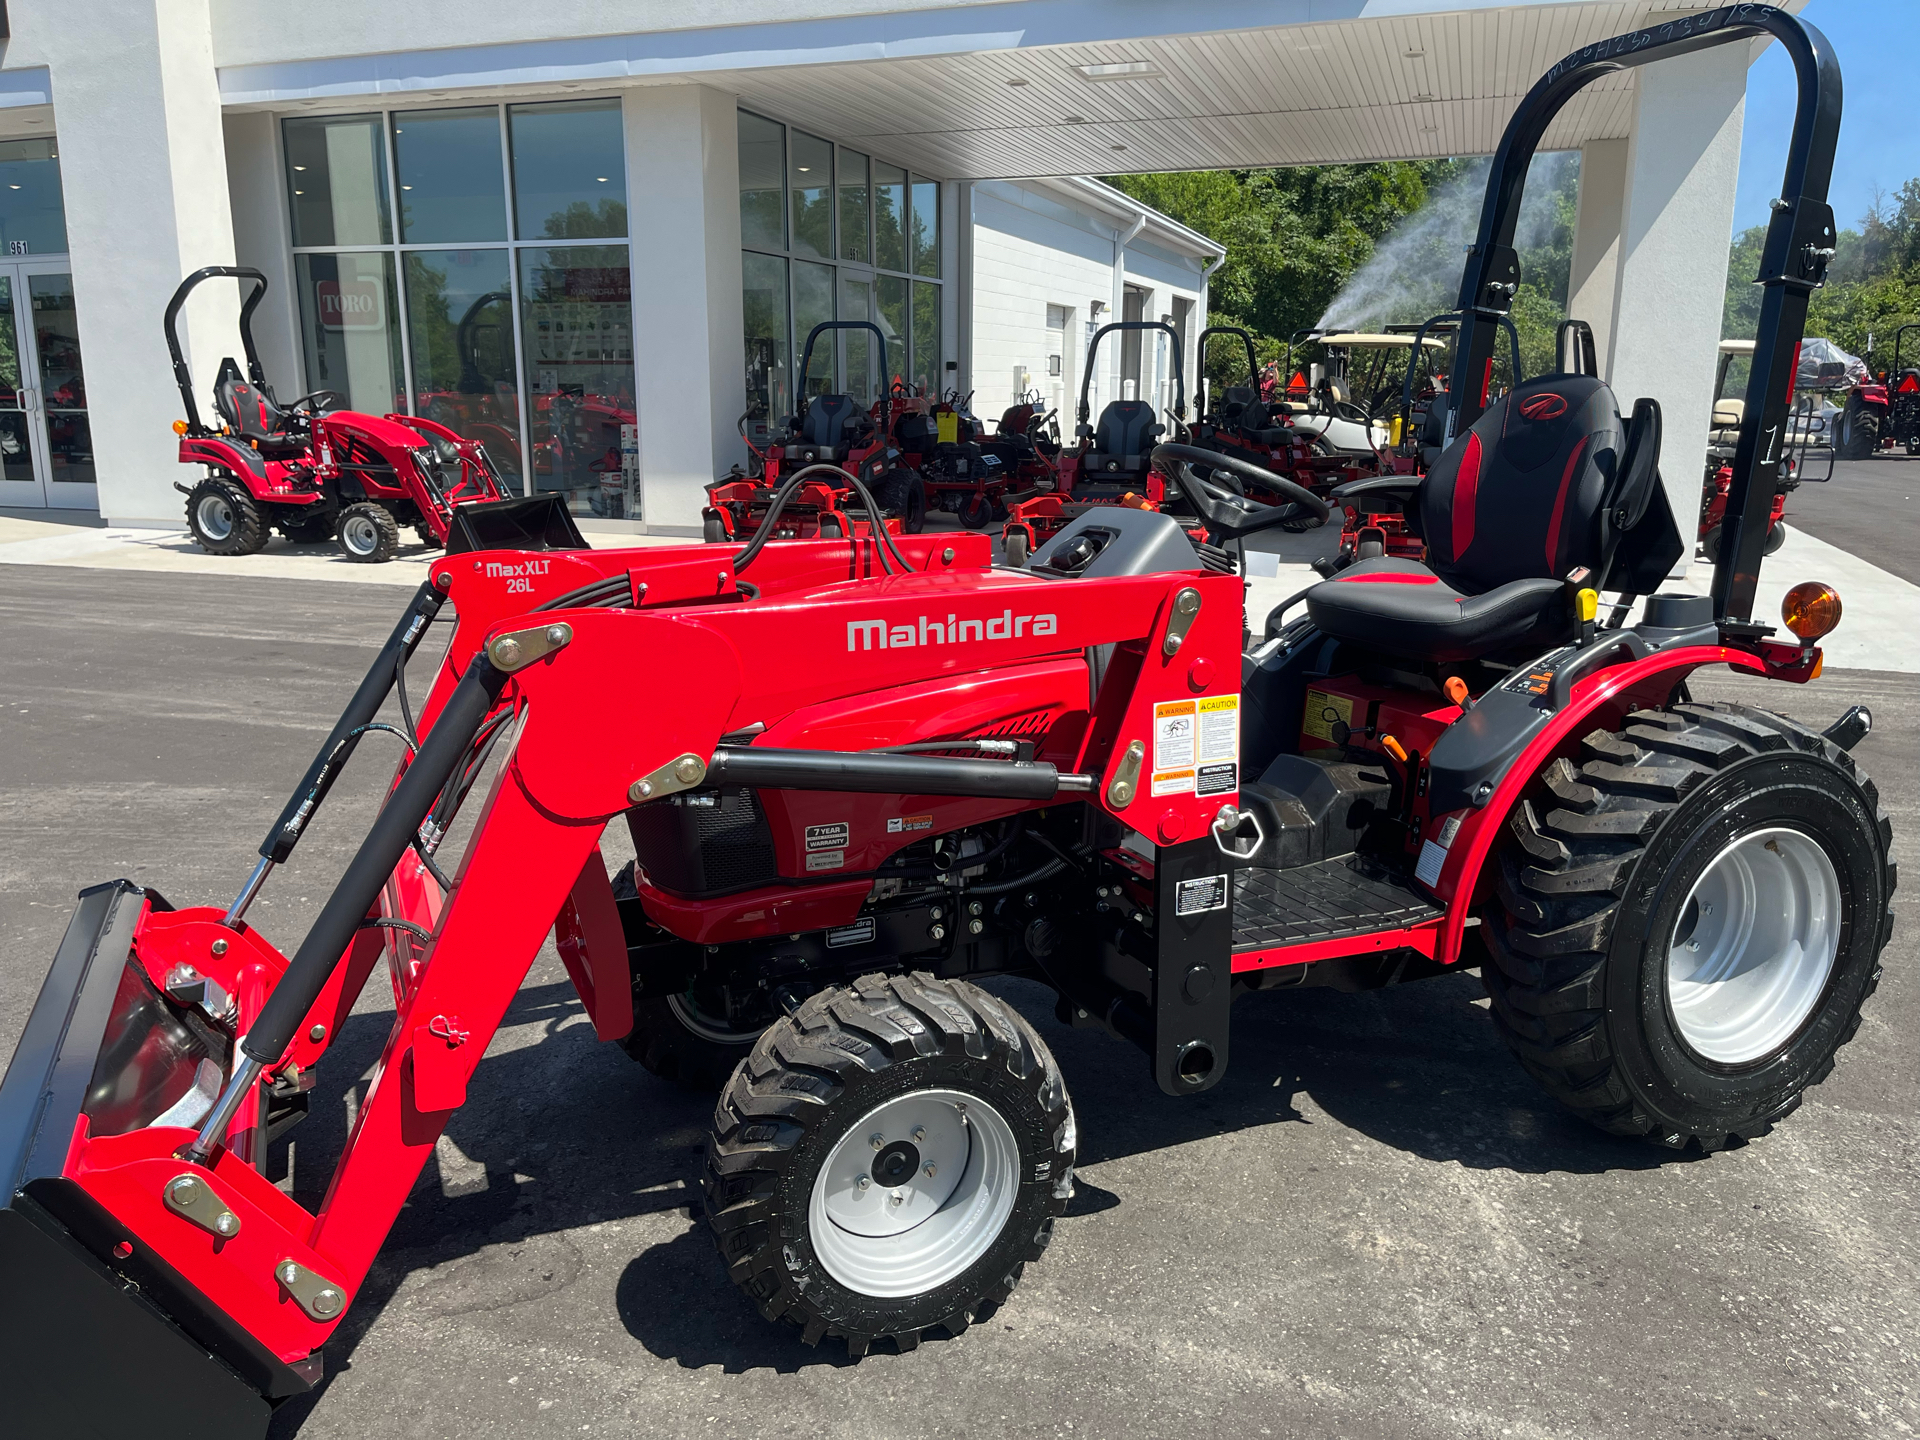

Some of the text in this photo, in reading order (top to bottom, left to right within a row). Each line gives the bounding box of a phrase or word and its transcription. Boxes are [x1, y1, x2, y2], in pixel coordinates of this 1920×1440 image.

[10, 241, 27, 254] 961
[570, 287, 615, 297] MAHINDRA
[322, 294, 373, 313] TORO
[1760, 424, 1777, 465] 1
[486, 560, 551, 578] MaxXLT
[506, 578, 535, 593] 26L
[847, 609, 1057, 652] Mahindra
[1165, 706, 1195, 714] WARNING
[1207, 700, 1237, 710] CAUTION
[821, 827, 841, 835] YEAR
[810, 838, 844, 848] WARRANTY
